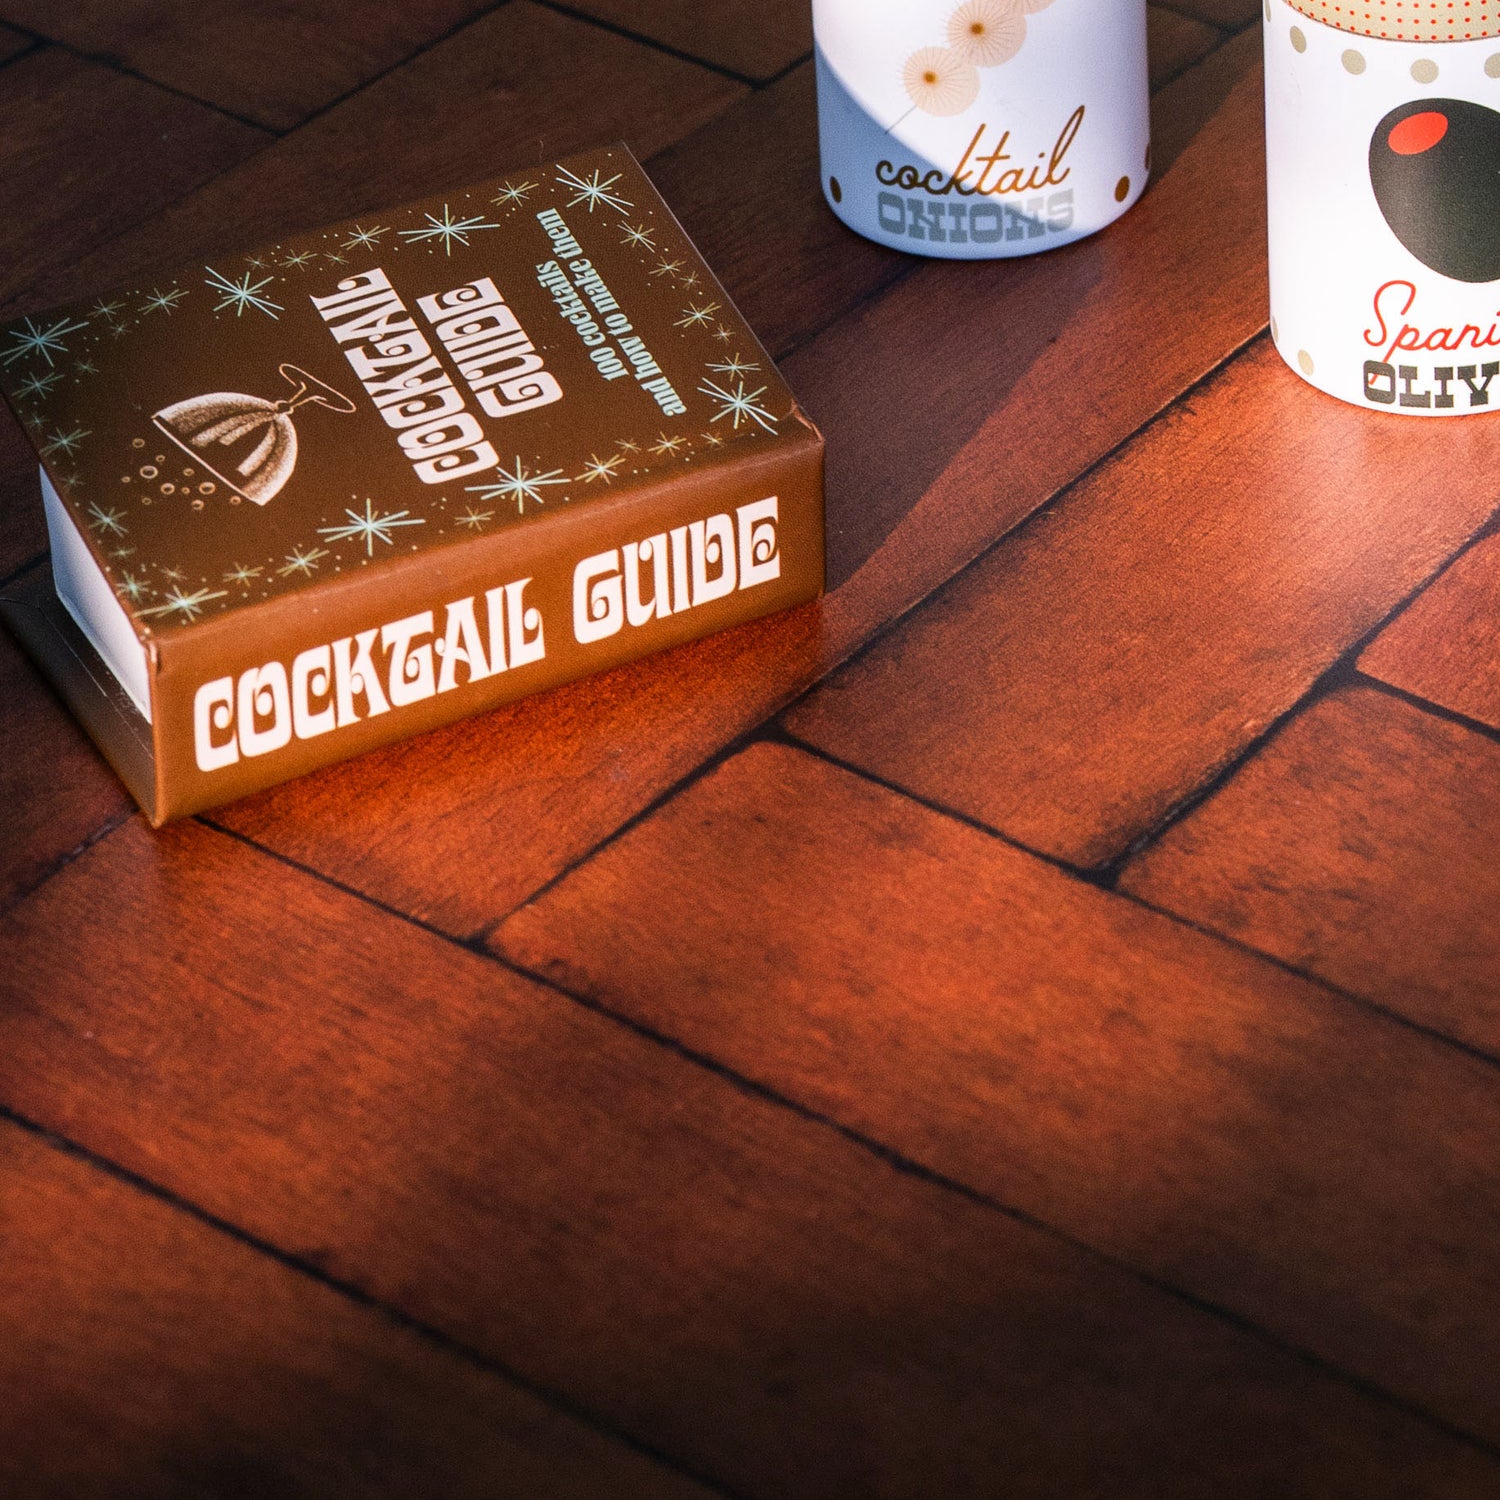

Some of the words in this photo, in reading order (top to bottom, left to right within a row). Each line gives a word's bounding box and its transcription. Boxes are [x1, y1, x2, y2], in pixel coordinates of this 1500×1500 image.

[875, 104, 1086, 197] cocktail
[535, 207, 584, 260] them
[877, 188, 1075, 244] ONIONS
[535, 259, 606, 347] cocktails
[568, 257, 621, 315] make
[415, 277, 564, 418] GUIDE
[603, 312, 634, 337] to
[310, 267, 500, 485] COCKTAIL
[589, 346, 630, 382] 100
[617, 335, 662, 381] how
[640, 375, 688, 418] and
[193, 576, 547, 773] COCKTAIL
[572, 496, 781, 645] GUIDE
